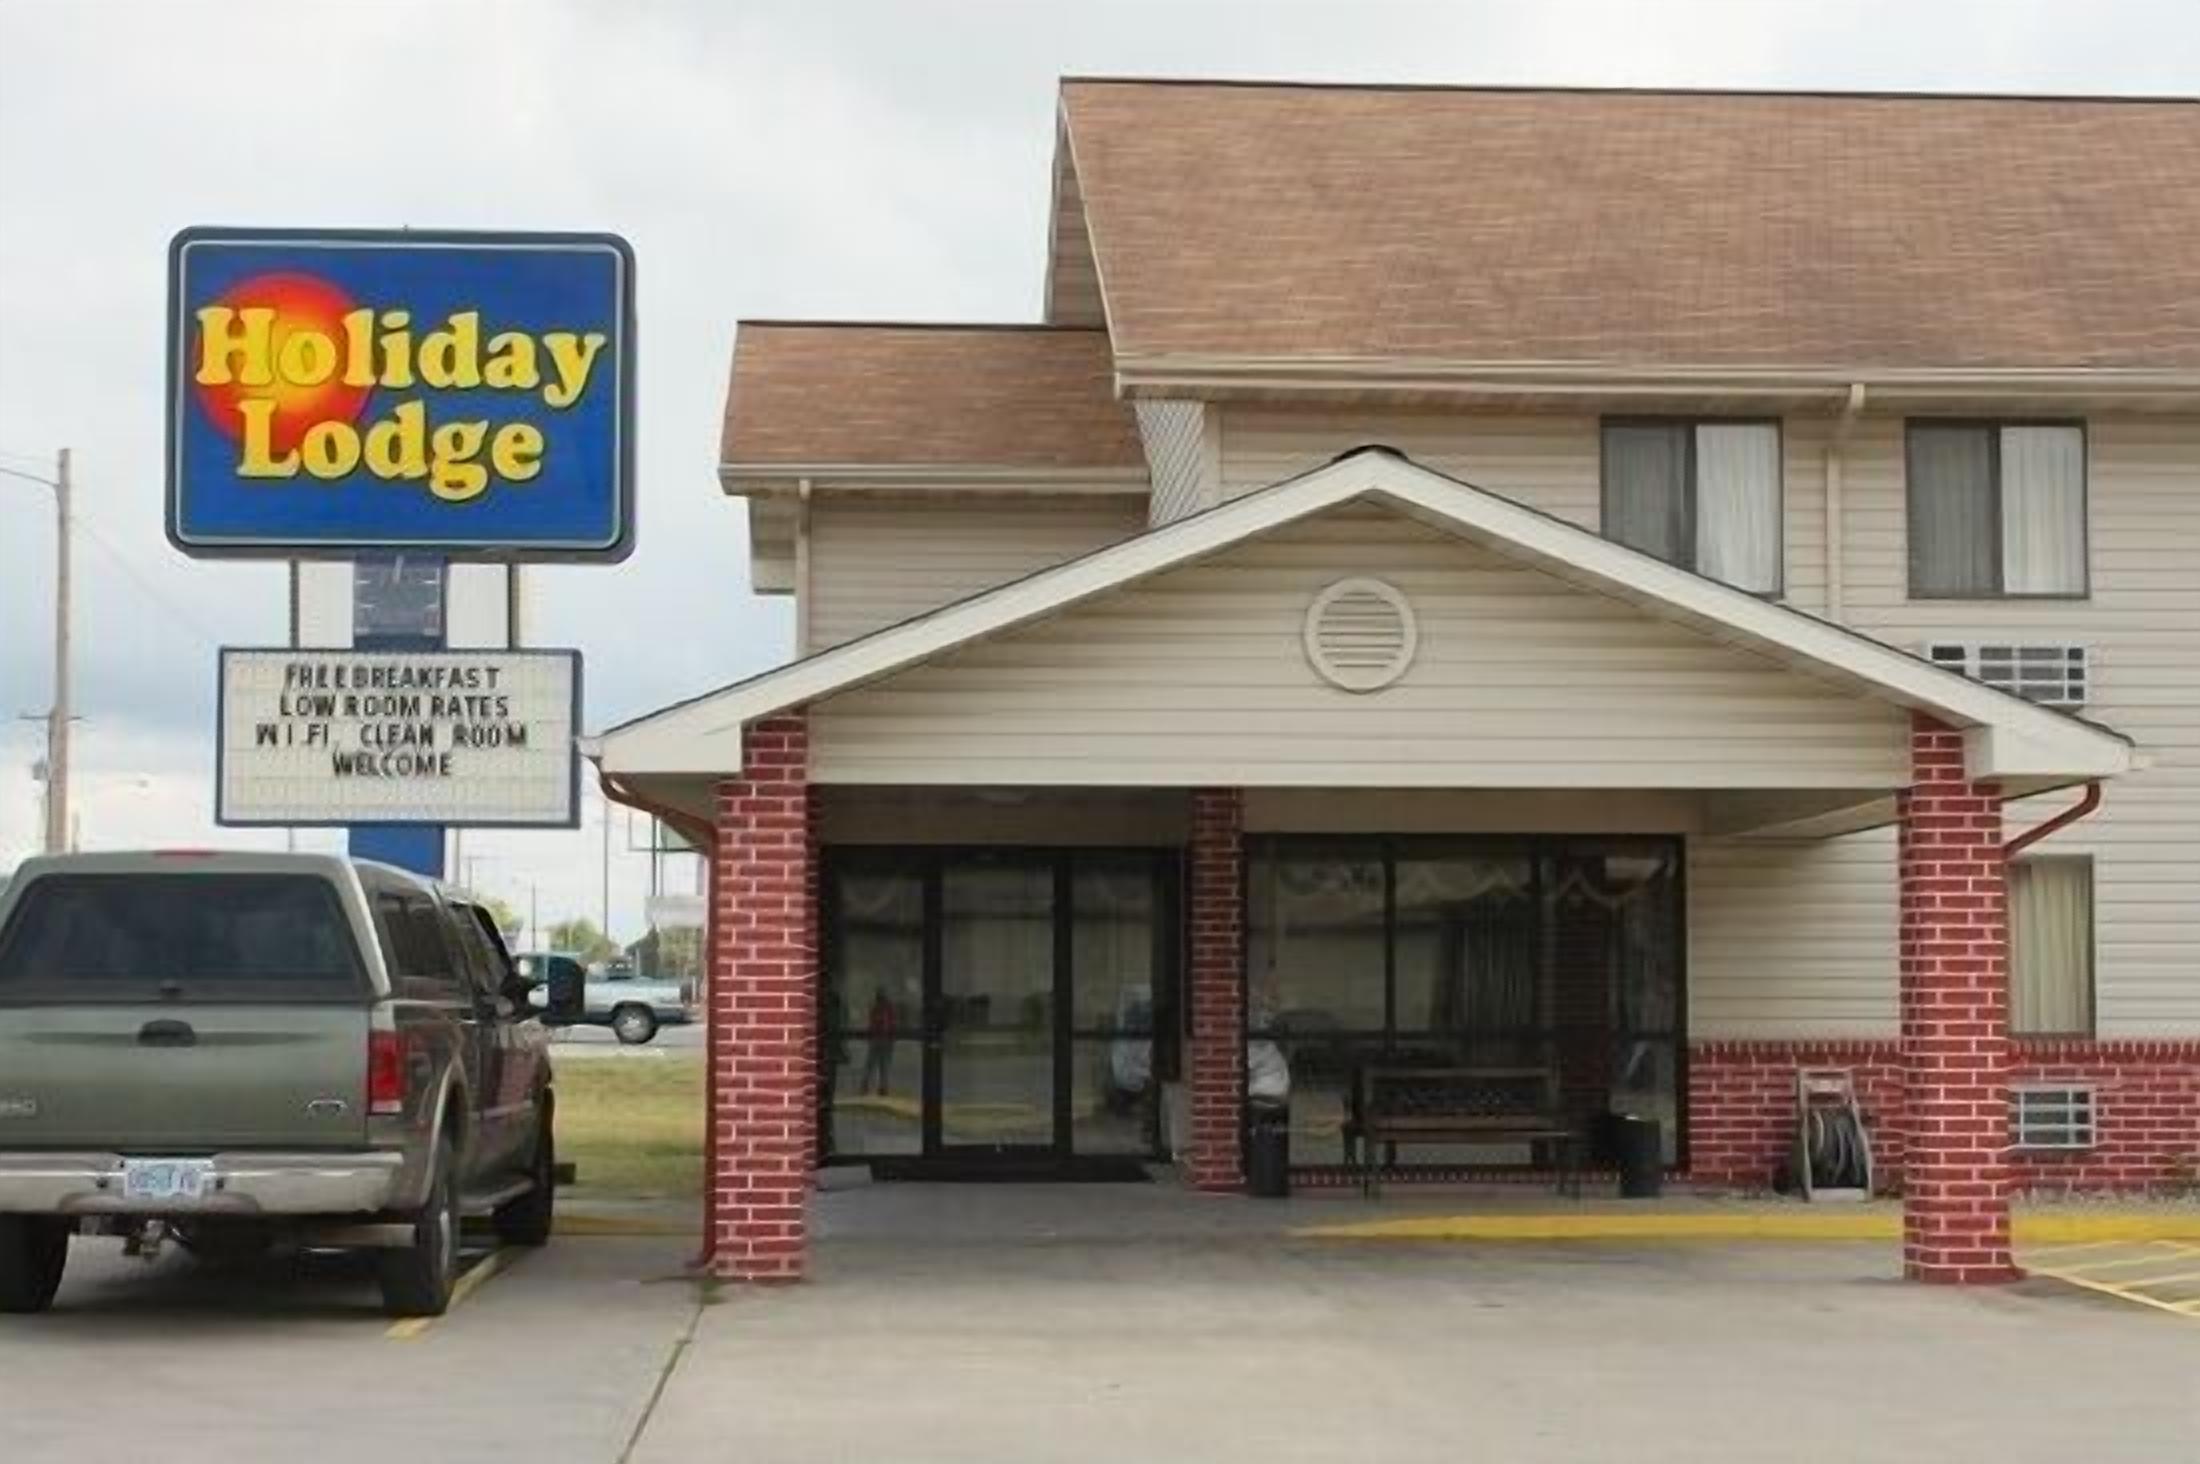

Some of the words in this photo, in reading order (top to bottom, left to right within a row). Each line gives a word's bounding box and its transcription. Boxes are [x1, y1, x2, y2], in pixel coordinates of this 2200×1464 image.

[195, 305, 606, 407] Holiday
[236, 399, 544, 500] Lodge
[280, 696, 336, 716] LOW
[344, 696, 420, 716] ROOM
[431, 696, 508, 716] RATES
[360, 723, 434, 746] CLEAN
[452, 724, 527, 747] ROOM
[333, 752, 452, 776] WELCOME
